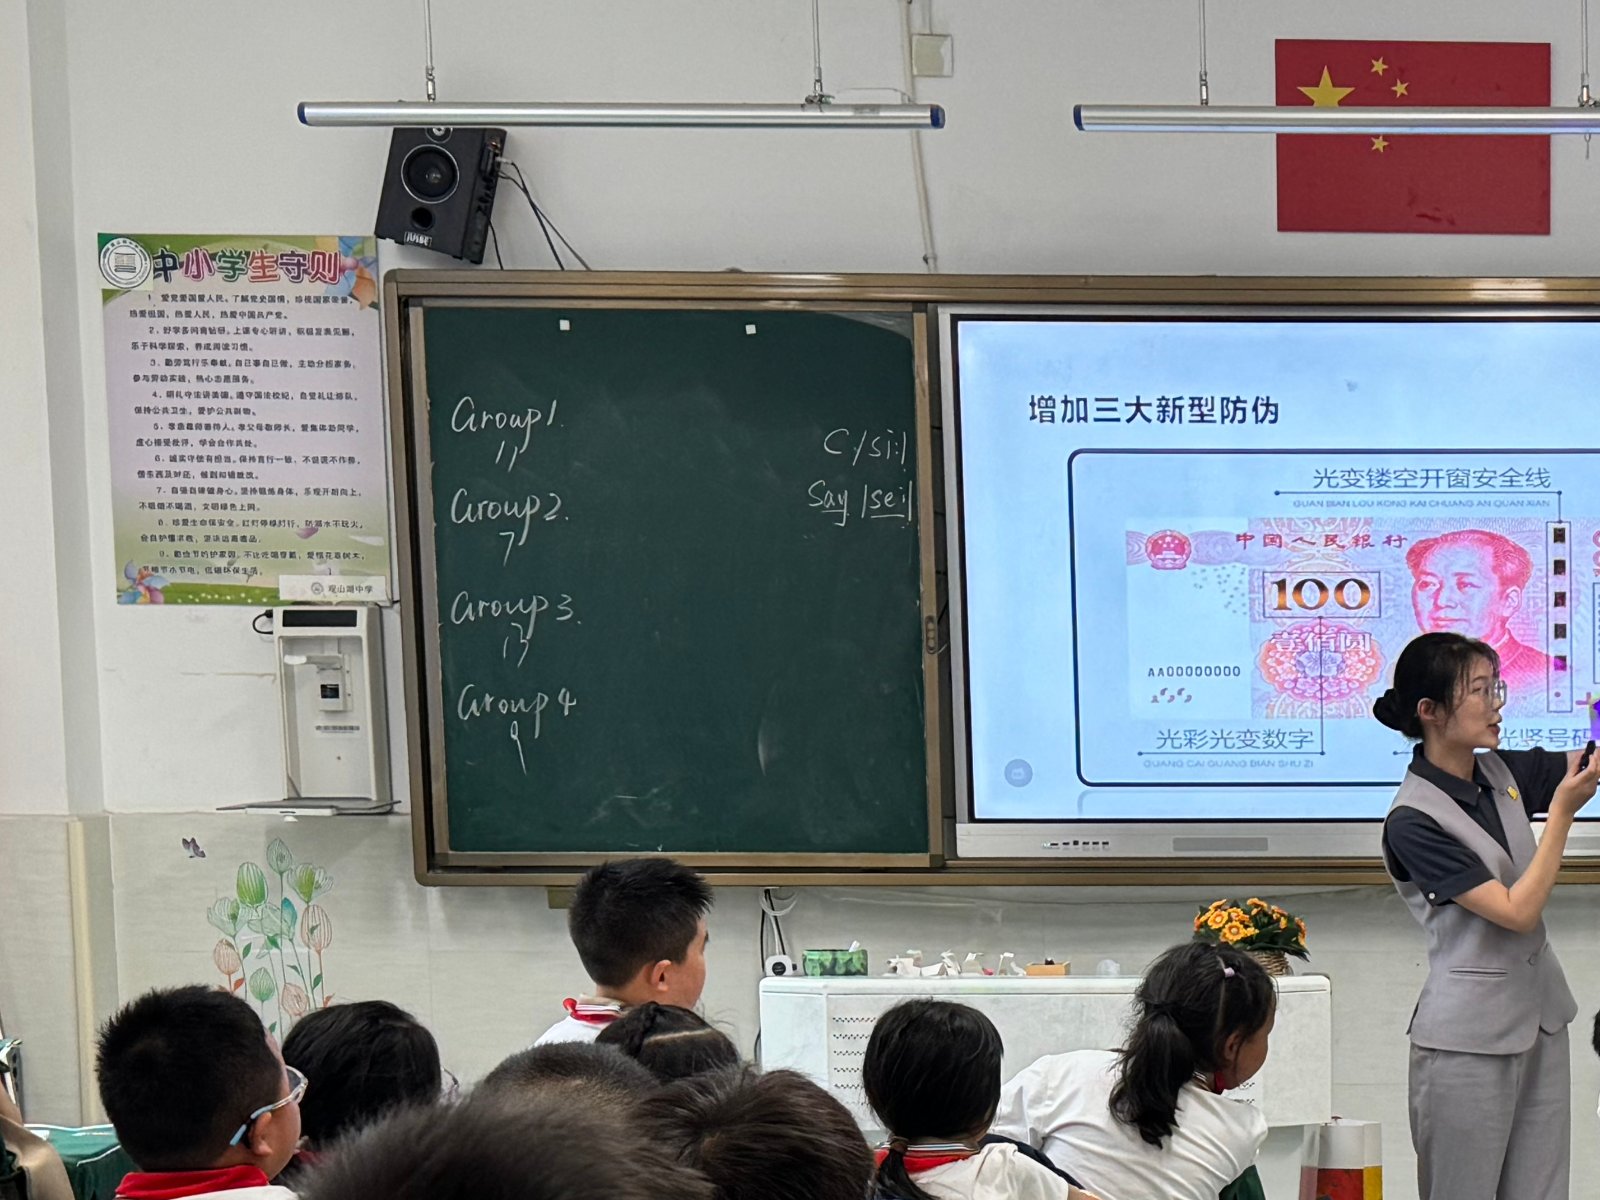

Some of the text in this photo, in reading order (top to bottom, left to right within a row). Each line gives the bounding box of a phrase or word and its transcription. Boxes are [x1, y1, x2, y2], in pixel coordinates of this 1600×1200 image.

[153, 248, 341, 284] 中小学生守则
[1029, 394, 1280, 425] 增加三大新型防伪
[823, 428, 849, 456] C
[1313, 467, 1552, 490] 光变镂空开窗安全线
[808, 480, 848, 526] Say
[1476, 499, 1491, 509] AN
[1235, 531, 1408, 550] 中国人民银行
[1270, 578, 1371, 611] 100
[1148, 665, 1241, 677] AA00000000
[1156, 729, 1315, 750] 光彩光变数字
